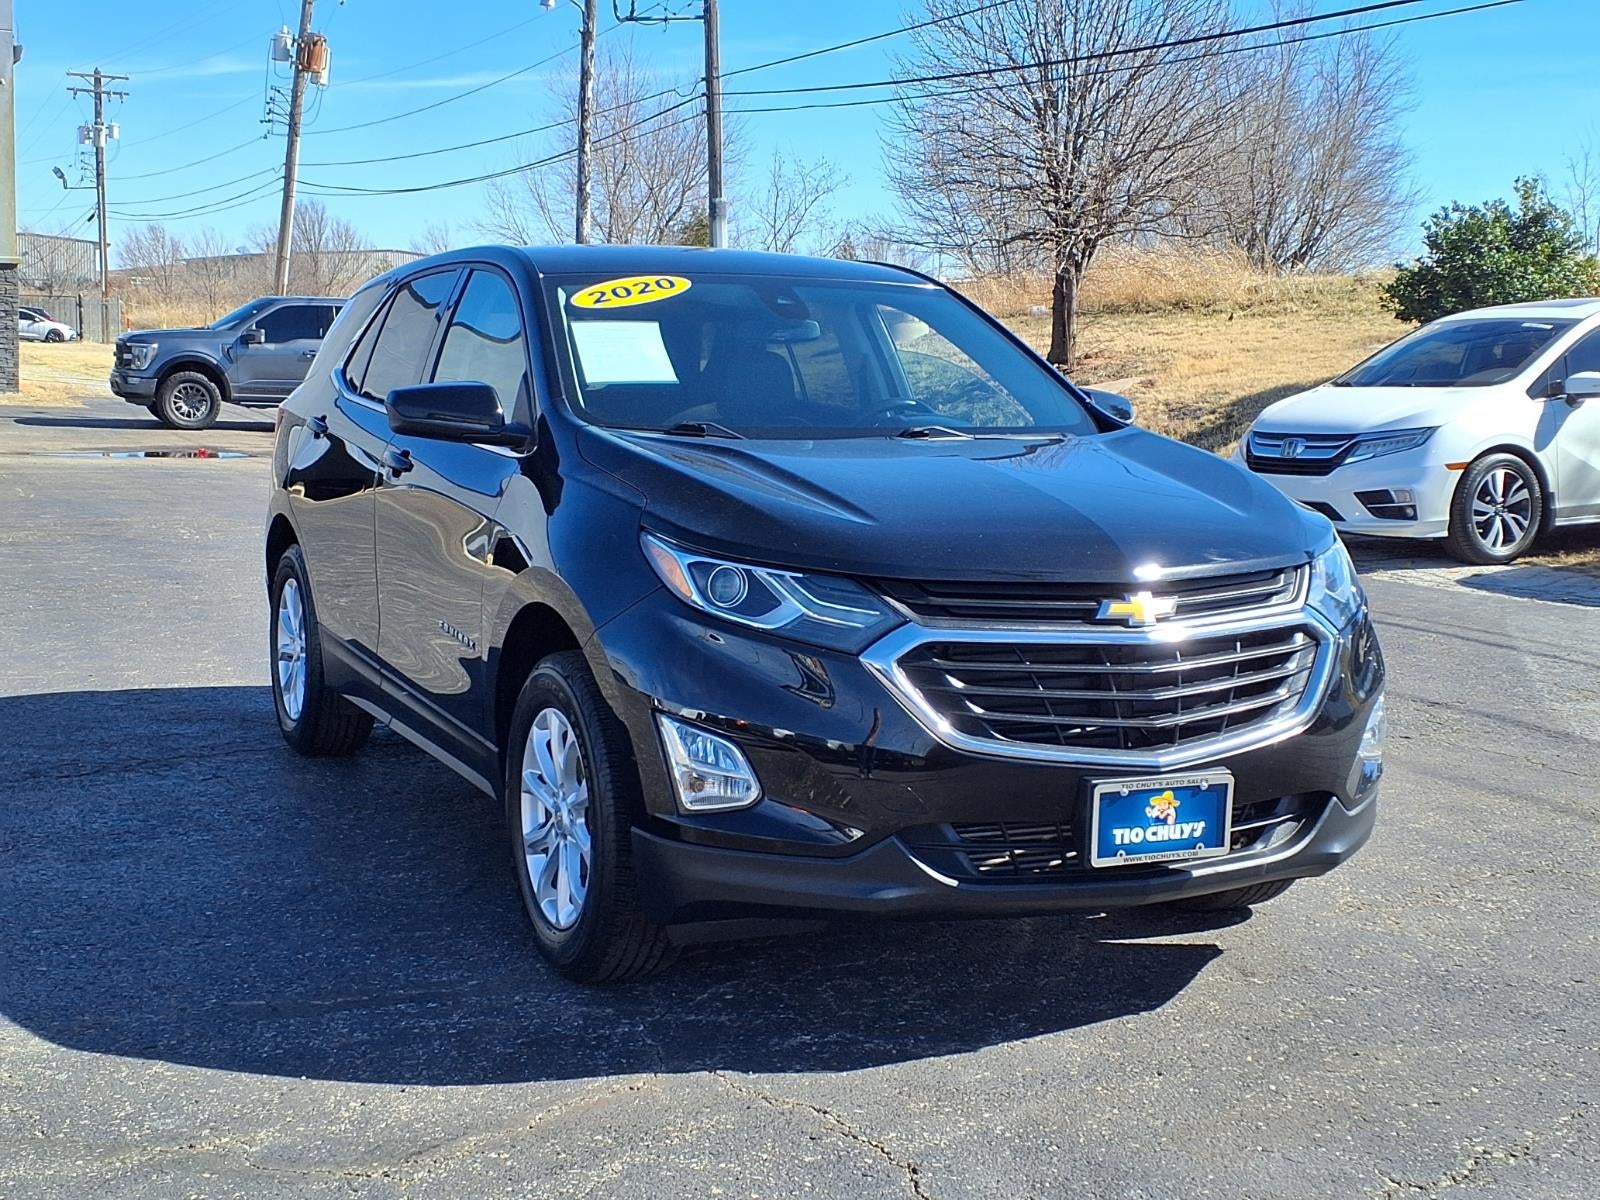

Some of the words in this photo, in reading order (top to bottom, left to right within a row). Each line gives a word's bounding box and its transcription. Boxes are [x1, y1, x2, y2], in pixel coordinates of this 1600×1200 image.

[588, 278, 676, 304] 2020
[1136, 781, 1163, 789] CHUY'S
[1165, 779, 1185, 787] AUTO
[1112, 827, 1144, 845] TIO
[1145, 821, 1206, 842] CHUY'S
